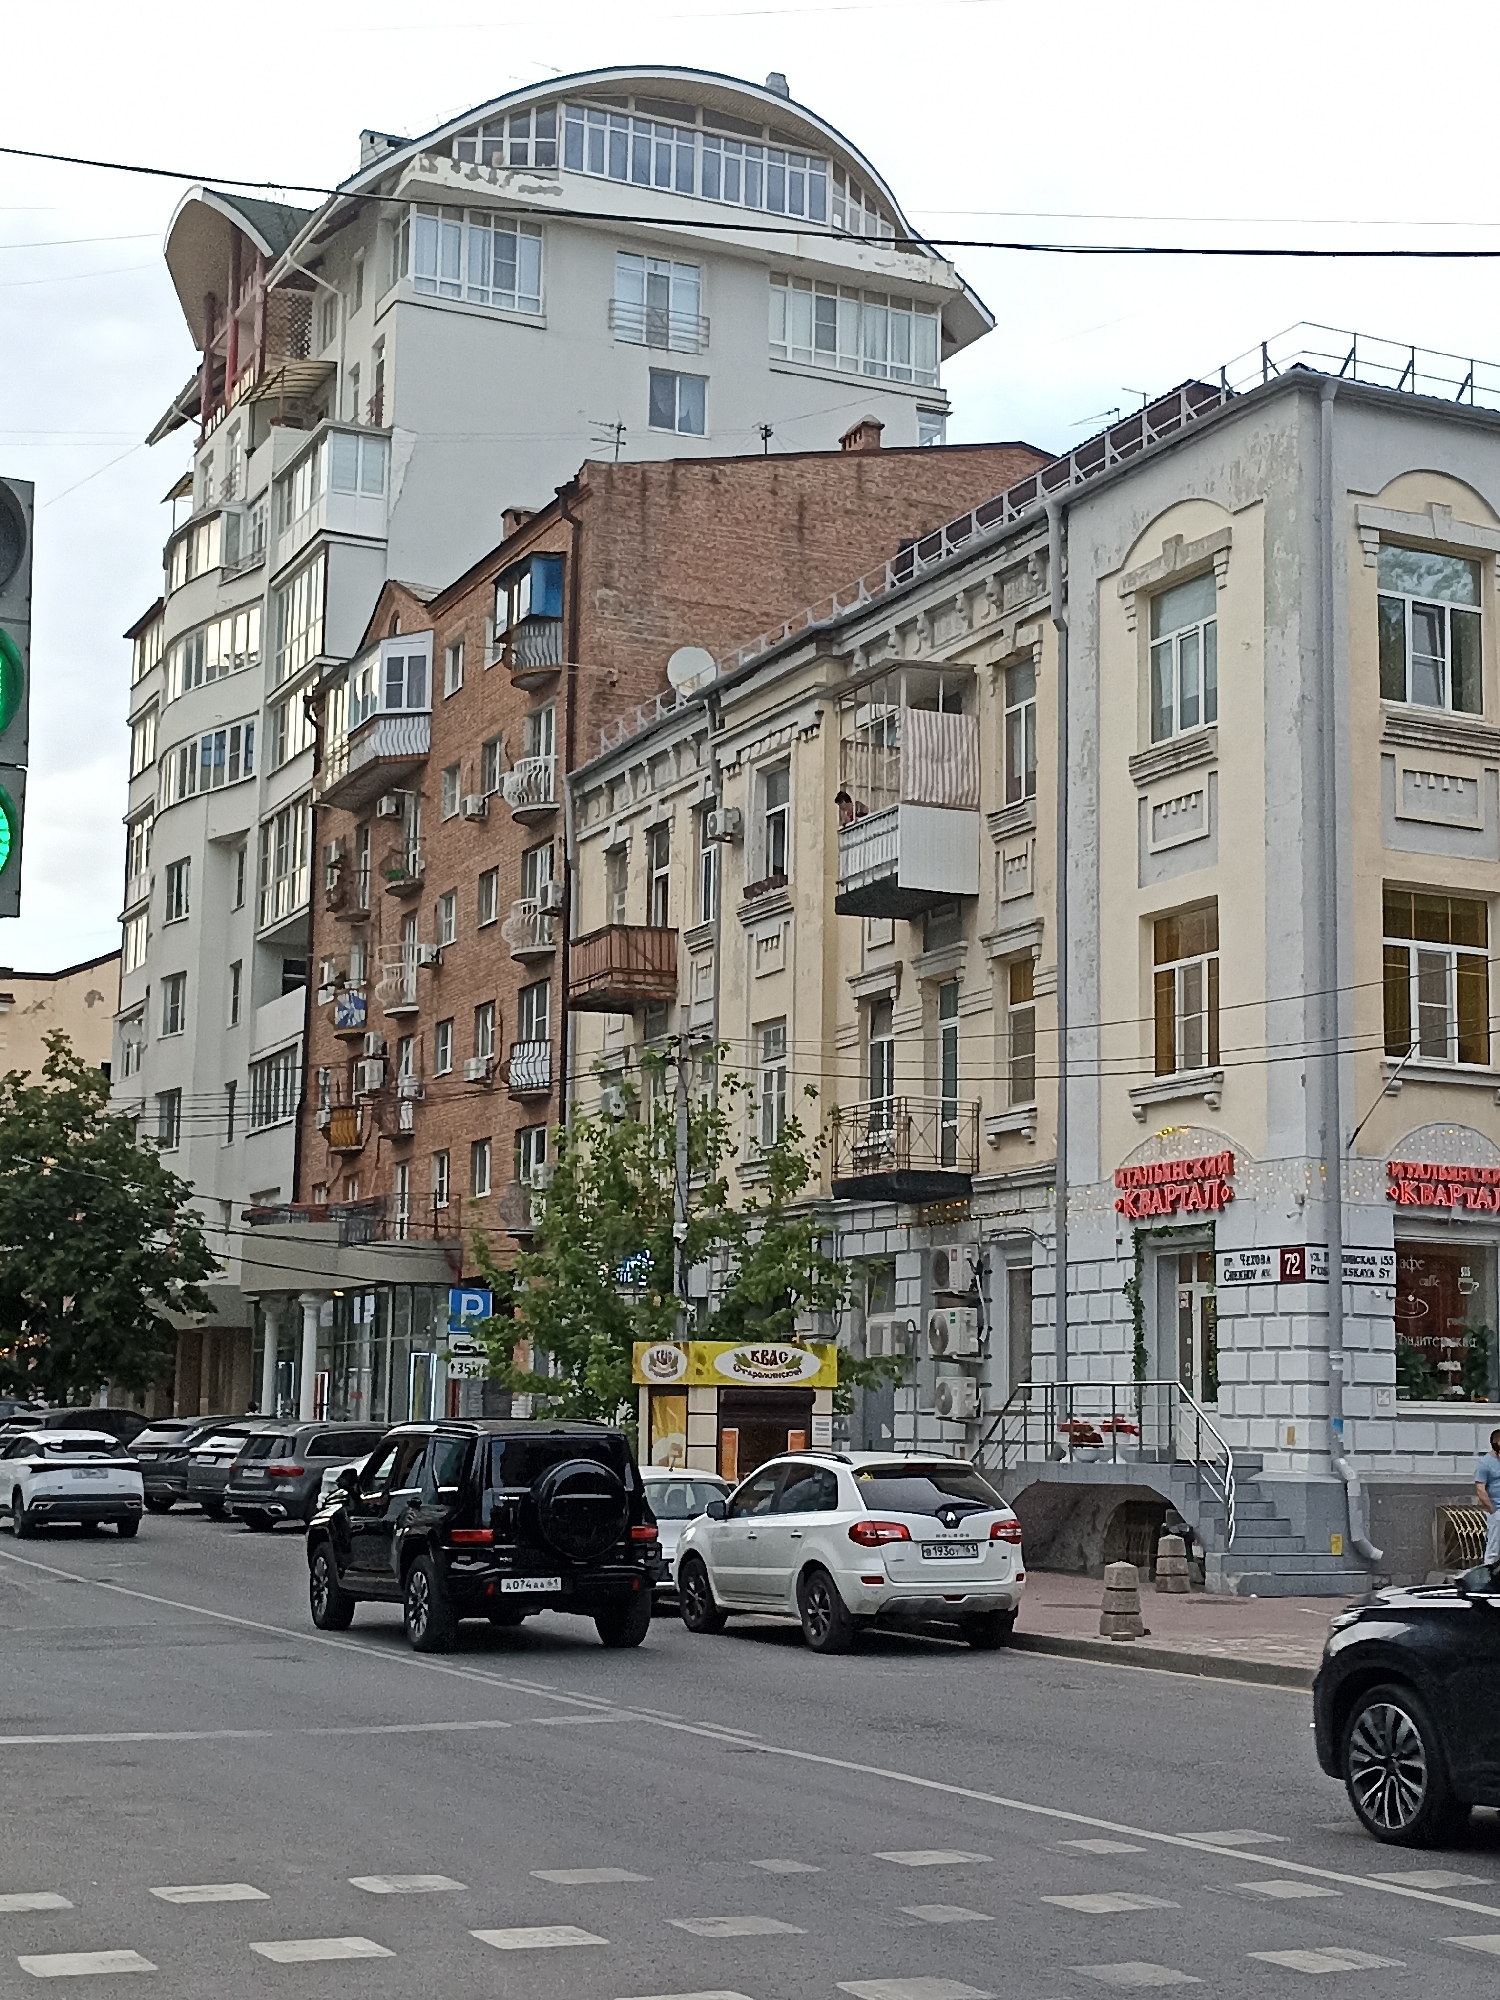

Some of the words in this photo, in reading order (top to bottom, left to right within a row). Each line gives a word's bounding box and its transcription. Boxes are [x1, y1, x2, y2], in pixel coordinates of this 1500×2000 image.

[1114, 1151, 1232, 1188] ИТАЛЬЯНСКИЙ
[1122, 1179, 1221, 1218] КВАРТАЛ
[1284, 1252, 1301, 1275] 72
[1397, 1256, 1425, 1273] афе
[750, 1350, 789, 1366] КВАС
